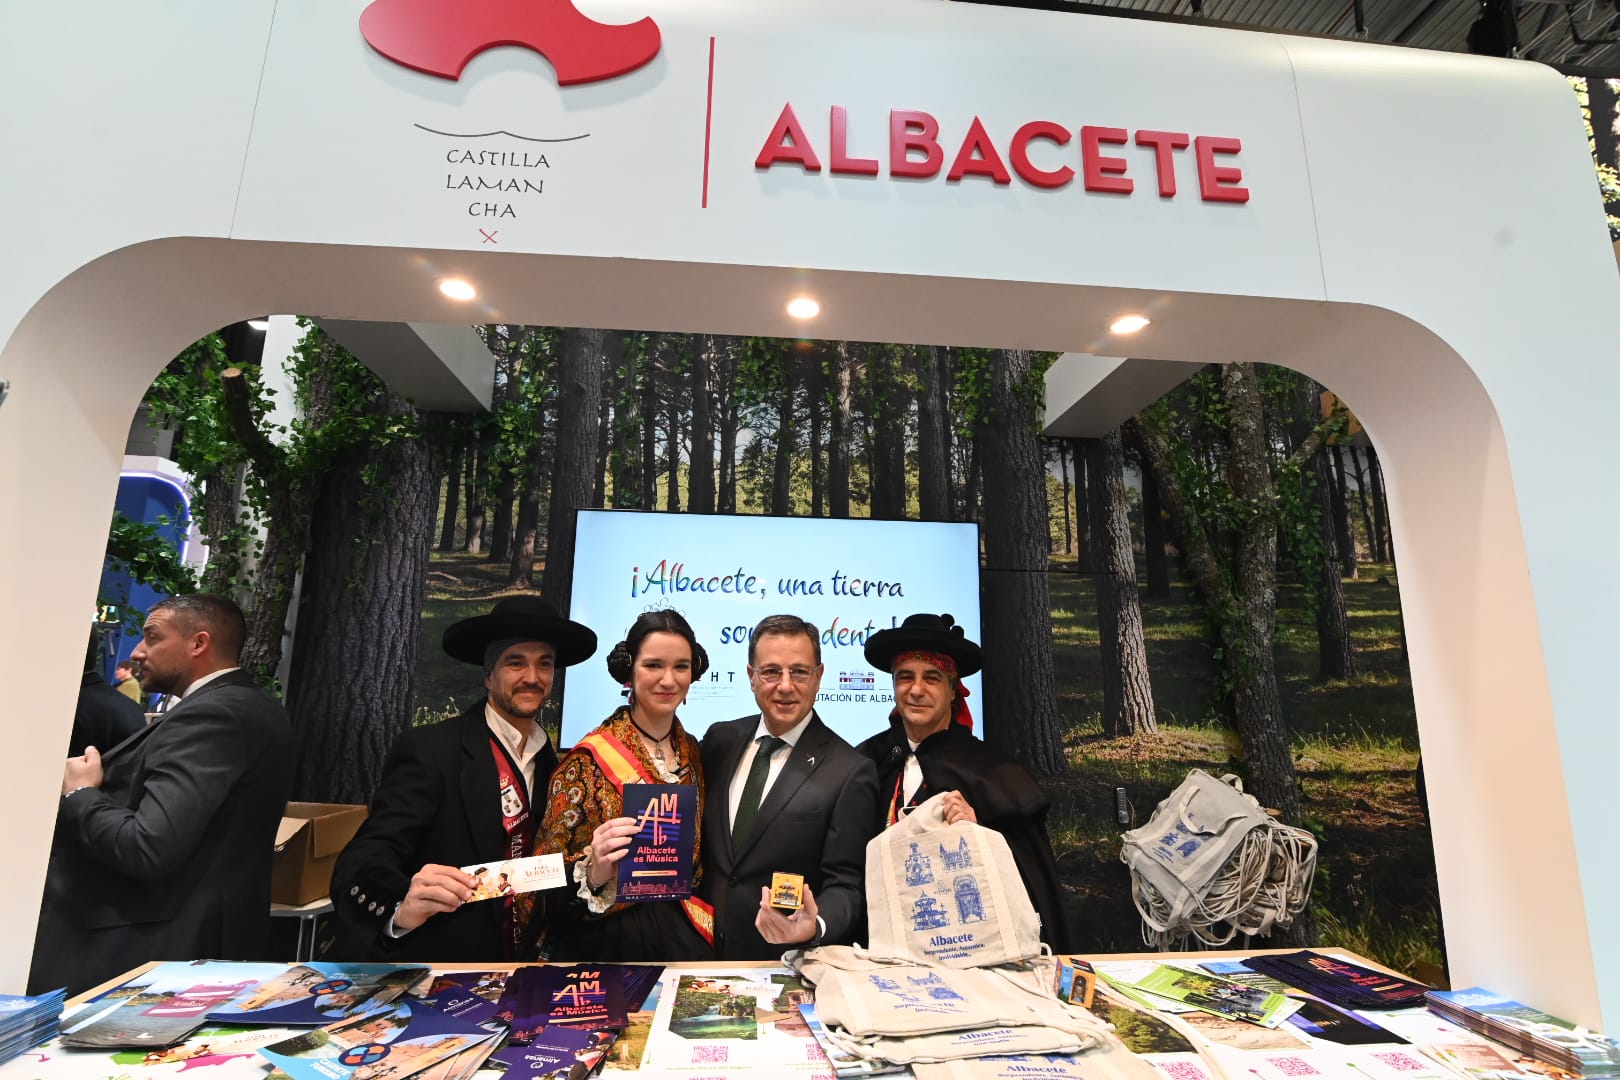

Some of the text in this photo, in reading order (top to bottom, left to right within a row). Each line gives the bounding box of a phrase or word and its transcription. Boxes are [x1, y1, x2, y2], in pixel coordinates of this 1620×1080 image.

[446, 149, 551, 169] CASTILLA
[754, 101, 1250, 204] ALBACETE
[446, 173, 544, 194] LAMAN
[468, 202, 517, 218] CHA
[778, 578, 825, 597] una
[831, 569, 905, 598] tierra
[854, 694, 867, 703] DE
[637, 846, 677, 855] Albacete
[646, 854, 679, 863] Música
[929, 931, 974, 947] Albacete
[553, 1004, 605, 1012] Albacete
[958, 1029, 1013, 1041] Albacete
[1006, 1065, 1067, 1074] Albacete
